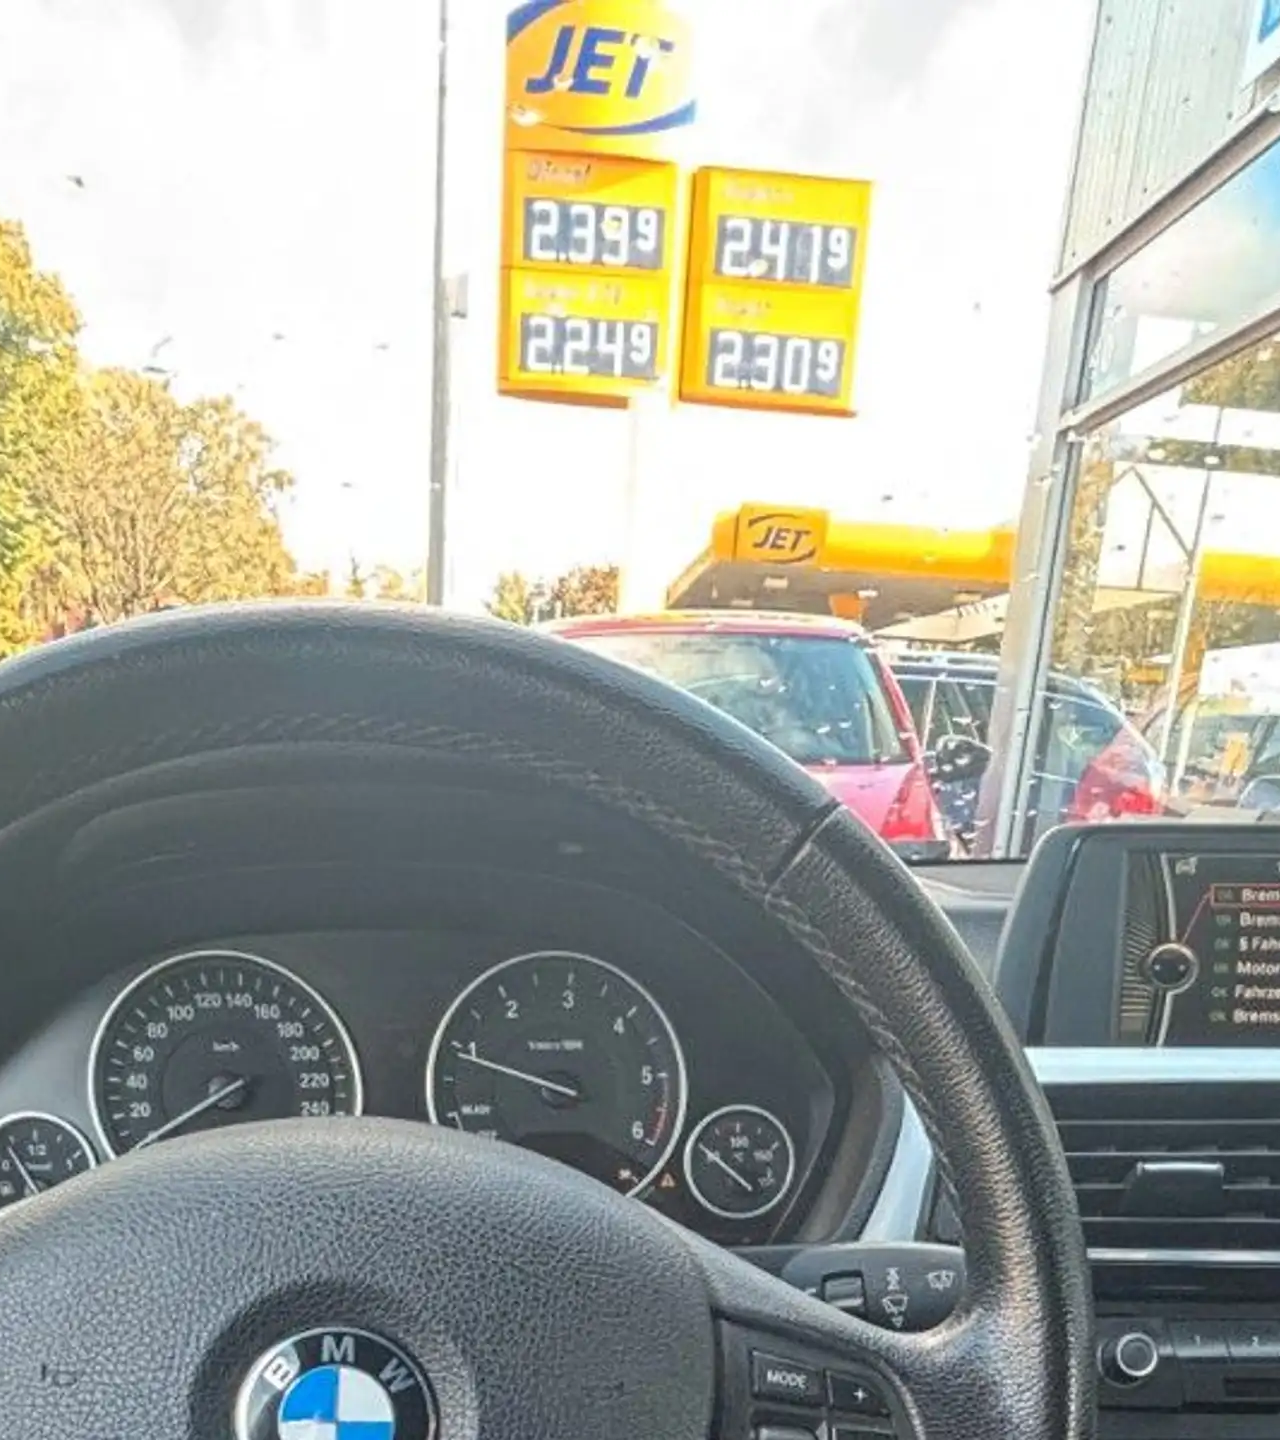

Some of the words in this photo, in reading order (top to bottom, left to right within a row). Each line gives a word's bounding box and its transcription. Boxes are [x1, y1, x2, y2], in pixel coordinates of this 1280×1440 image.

[524, 26, 674, 98] JET
[752, 526, 812, 553] JET
[196, 993, 220, 1008] 120
[225, 993, 252, 1008] 140
[562, 990, 574, 1009] 3
[167, 1005, 194, 1021] 100
[505, 1000, 518, 1018] 2
[147, 1022, 168, 1039] 80
[277, 1022, 304, 1038] 180
[613, 1016, 625, 1035] 4
[133, 1047, 154, 1061] 60
[290, 1046, 319, 1061] 200
[125, 1074, 147, 1089] 40
[299, 1073, 329, 1088] 220
[641, 1067, 653, 1085] 5
[129, 1101, 151, 1118] 20
[631, 1121, 644, 1140] 6
[263, 1335, 416, 1394] BMW
[766, 1369, 807, 1389] MODE
